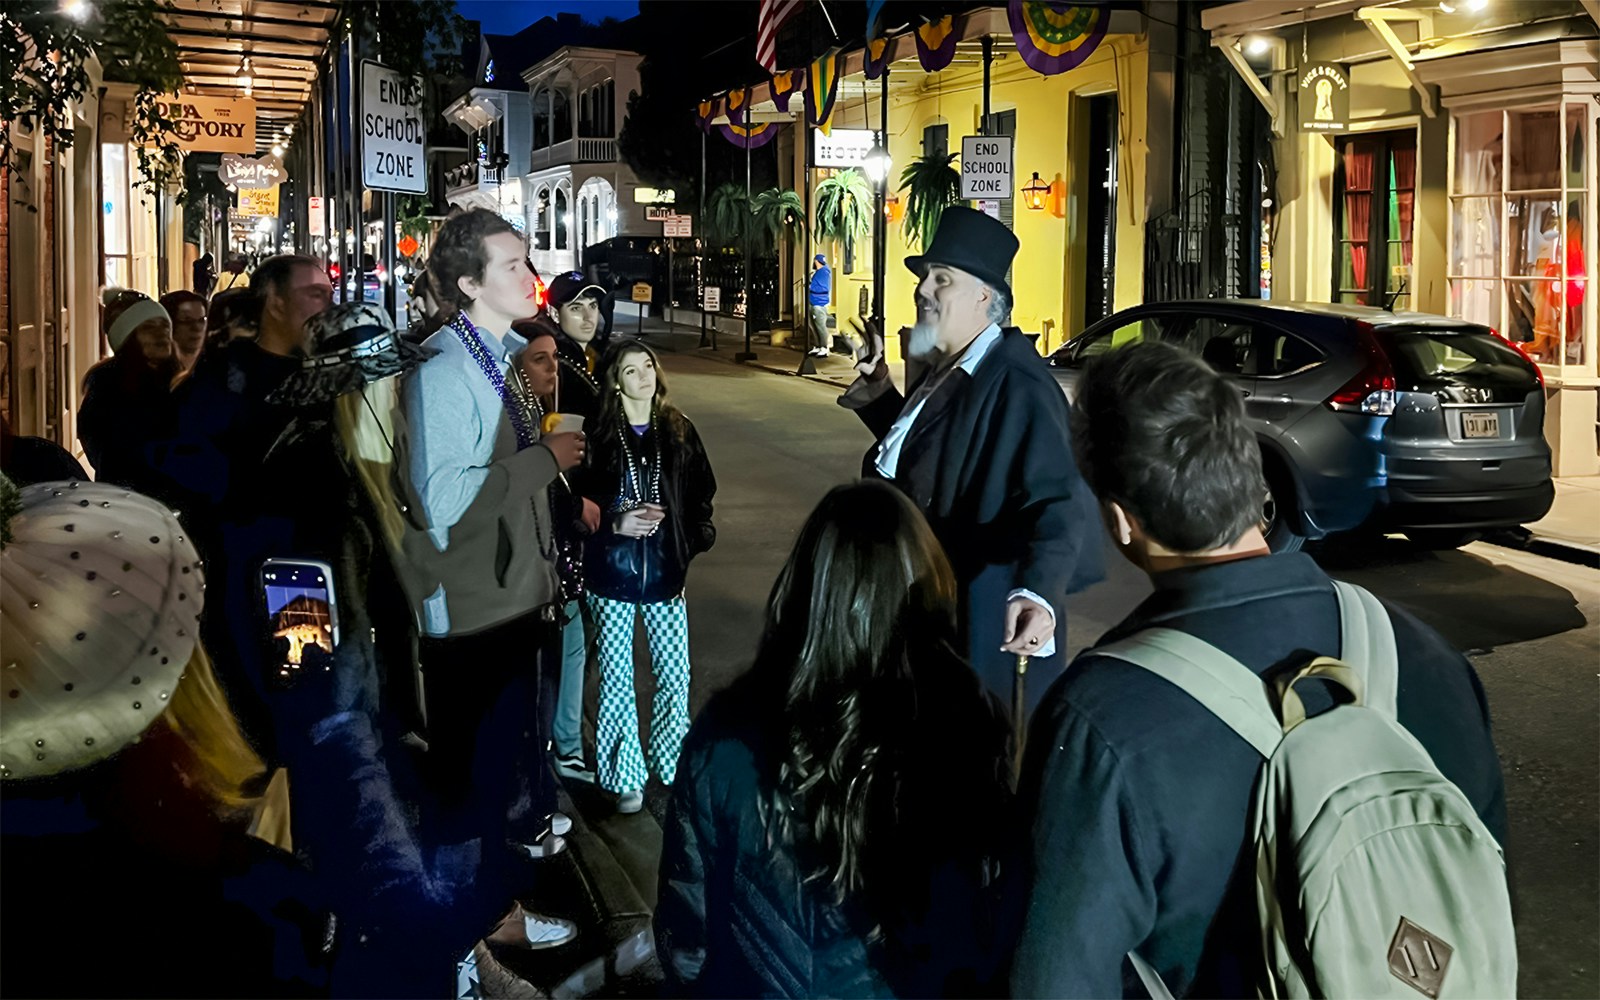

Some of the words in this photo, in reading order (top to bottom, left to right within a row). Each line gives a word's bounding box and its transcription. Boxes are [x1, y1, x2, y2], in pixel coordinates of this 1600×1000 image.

[173, 119, 246, 142] CTORY
[365, 113, 422, 144] SCHOOL
[975, 143, 999, 156] END
[376, 151, 414, 178] ZONE
[964, 161, 1009, 174] SCHOOL
[970, 179, 1002, 192] ZONE
